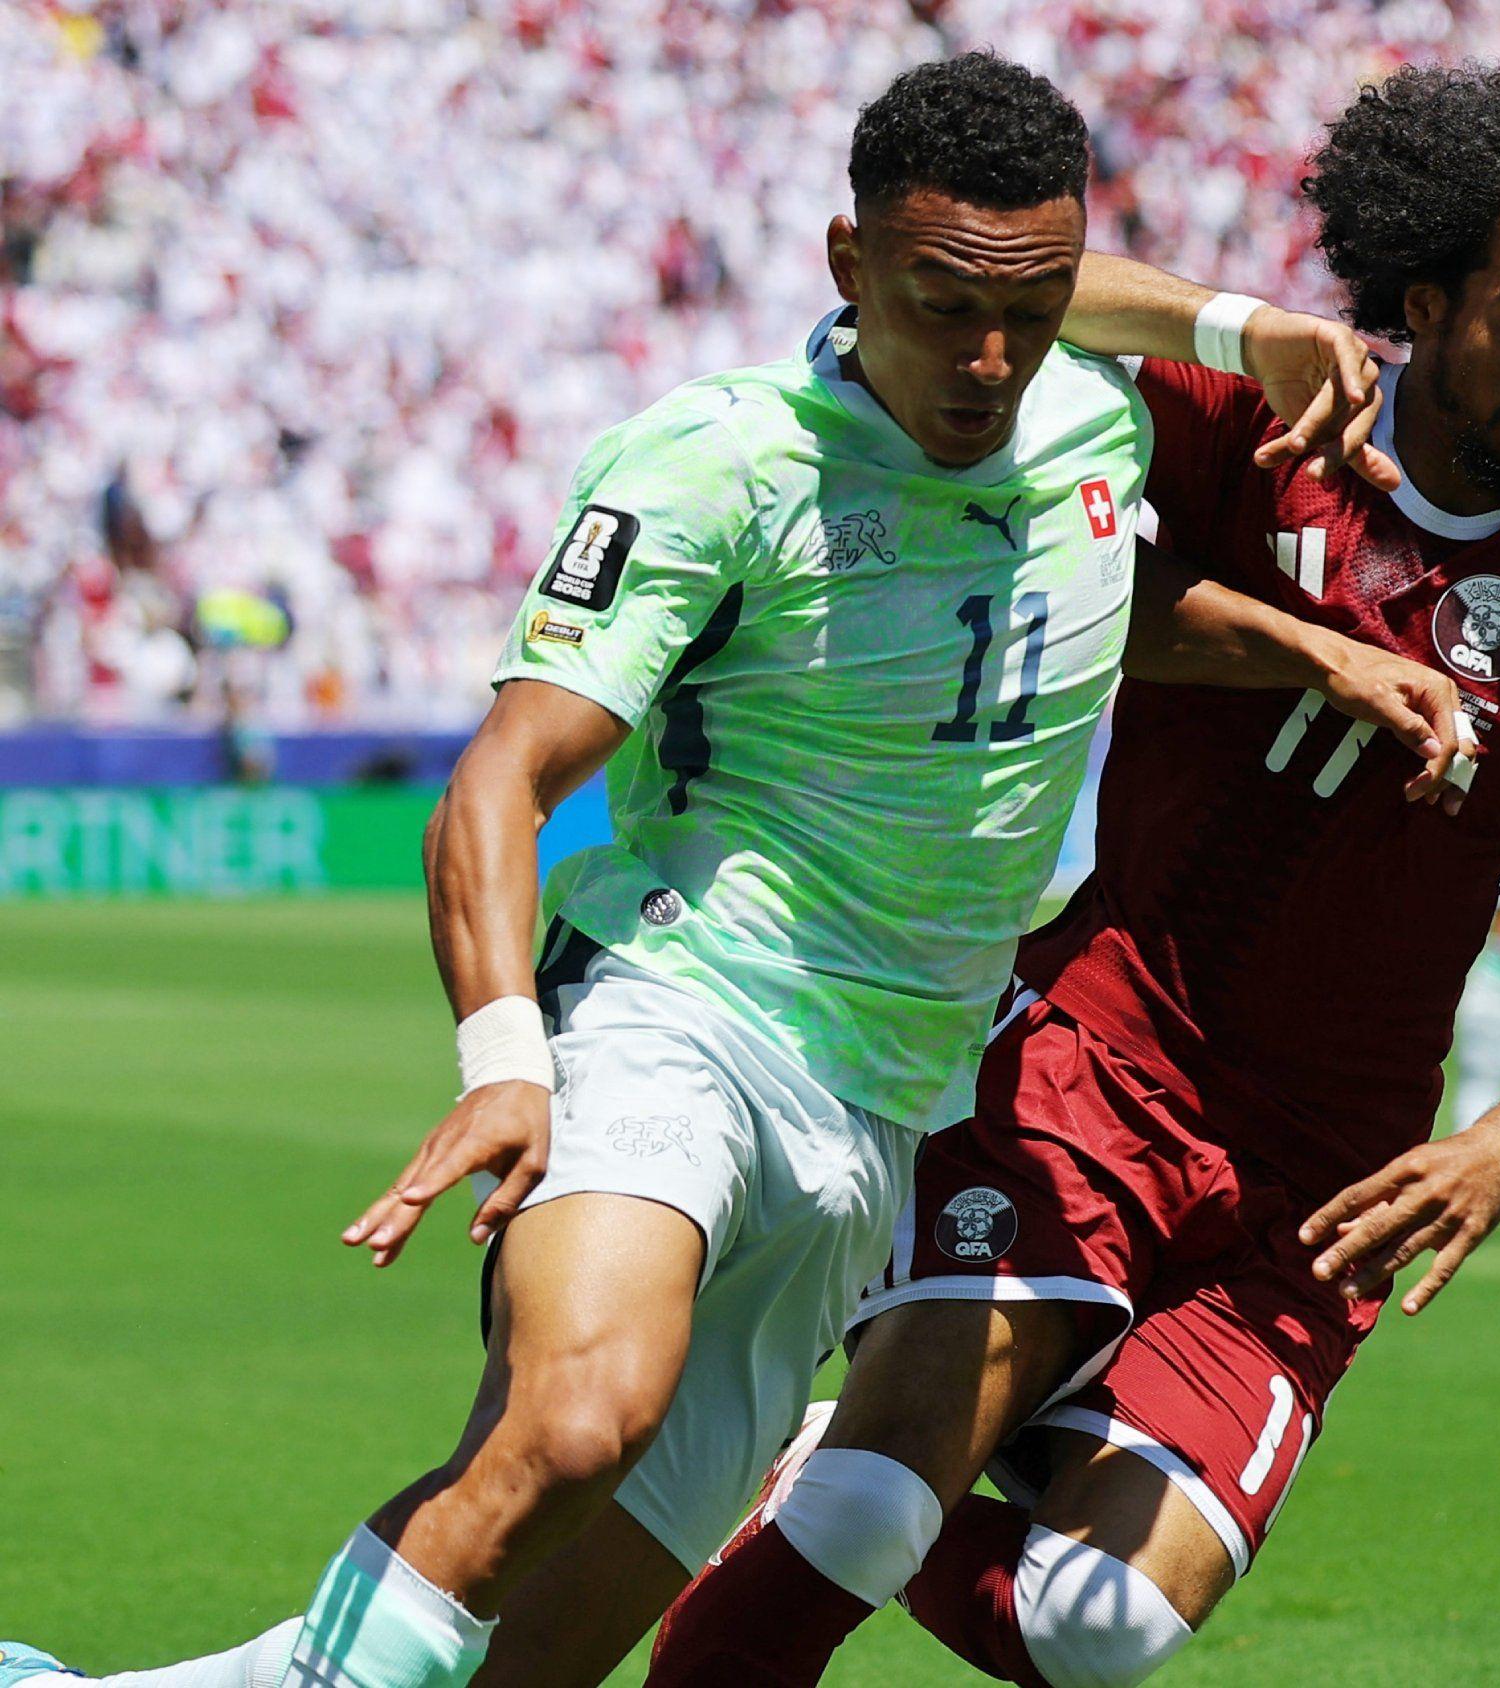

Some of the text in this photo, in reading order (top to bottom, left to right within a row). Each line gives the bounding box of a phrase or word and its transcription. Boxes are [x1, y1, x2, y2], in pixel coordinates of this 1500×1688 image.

[556, 572, 595, 589] WORLD CUP
[551, 580, 592, 600] 2026
[544, 623, 582, 637] DEBUT
[931, 592, 1050, 743] 11
[1450, 643, 1493, 677] QFA
[955, 1241, 993, 1257] QFA
